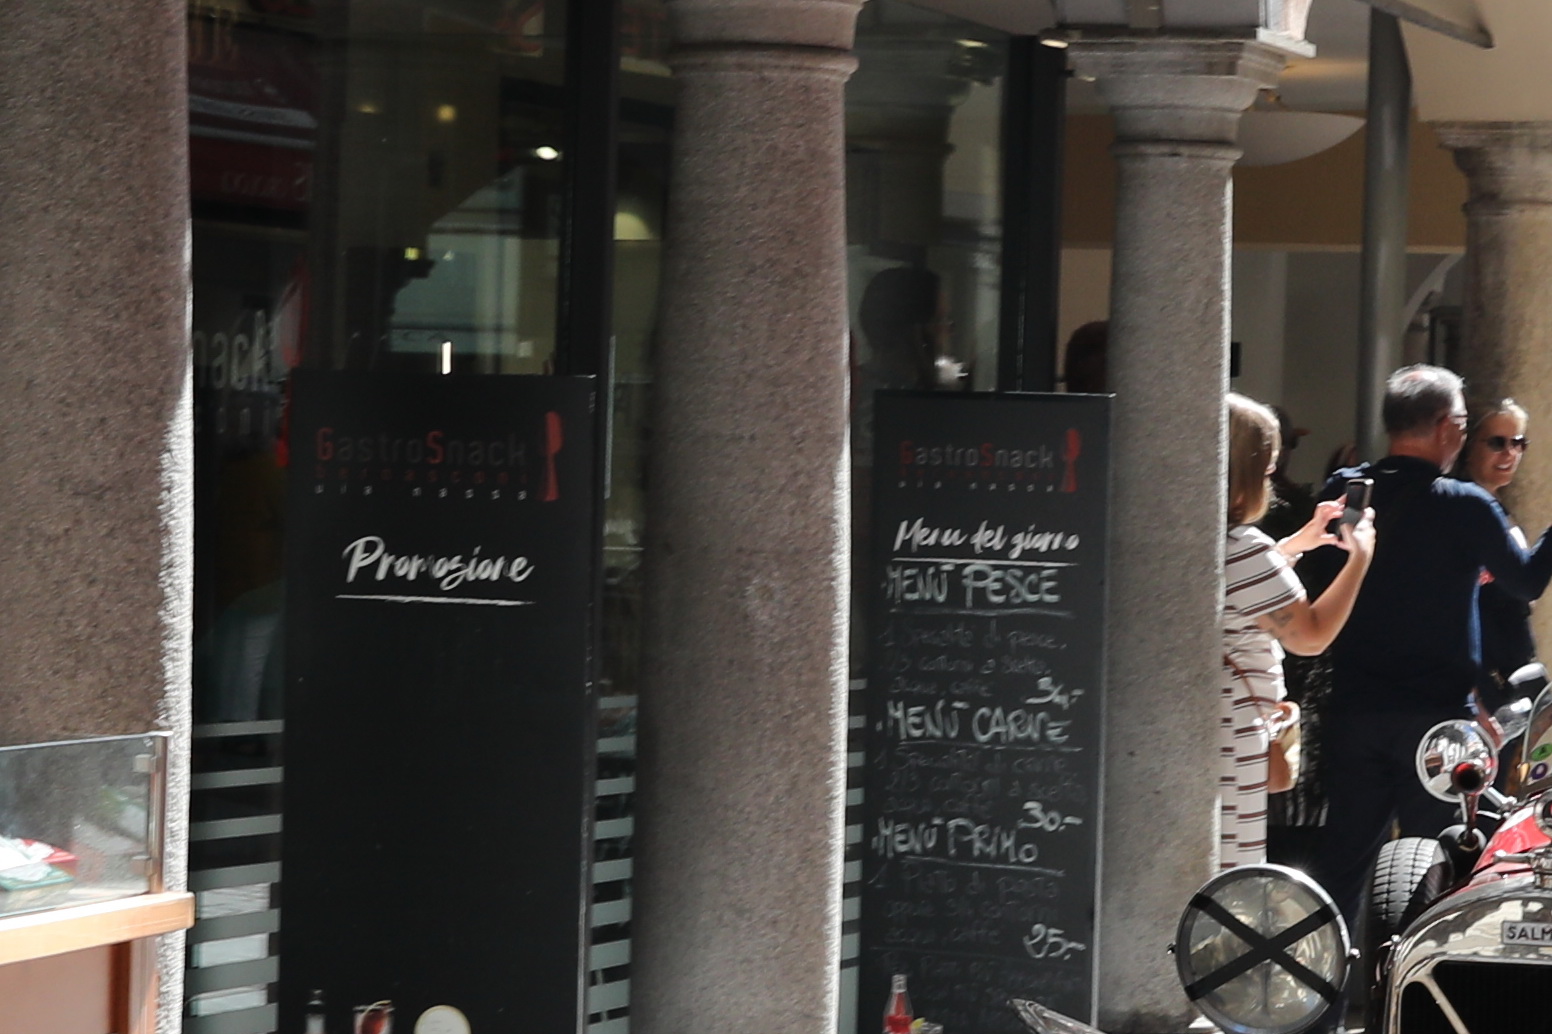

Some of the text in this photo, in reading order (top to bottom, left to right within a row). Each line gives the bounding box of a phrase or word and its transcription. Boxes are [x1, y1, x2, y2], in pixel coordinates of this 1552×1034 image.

[315, 427, 526, 466] GastroSnack
[899, 440, 1054, 468] GastroSnack
[892, 517, 968, 554] Menu
[969, 519, 1009, 555] del
[342, 535, 536, 591] Promozione
[961, 563, 1061, 608] PESCE
[971, 705, 1074, 744] CARNE
[946, 818, 1039, 864] PRIMO
